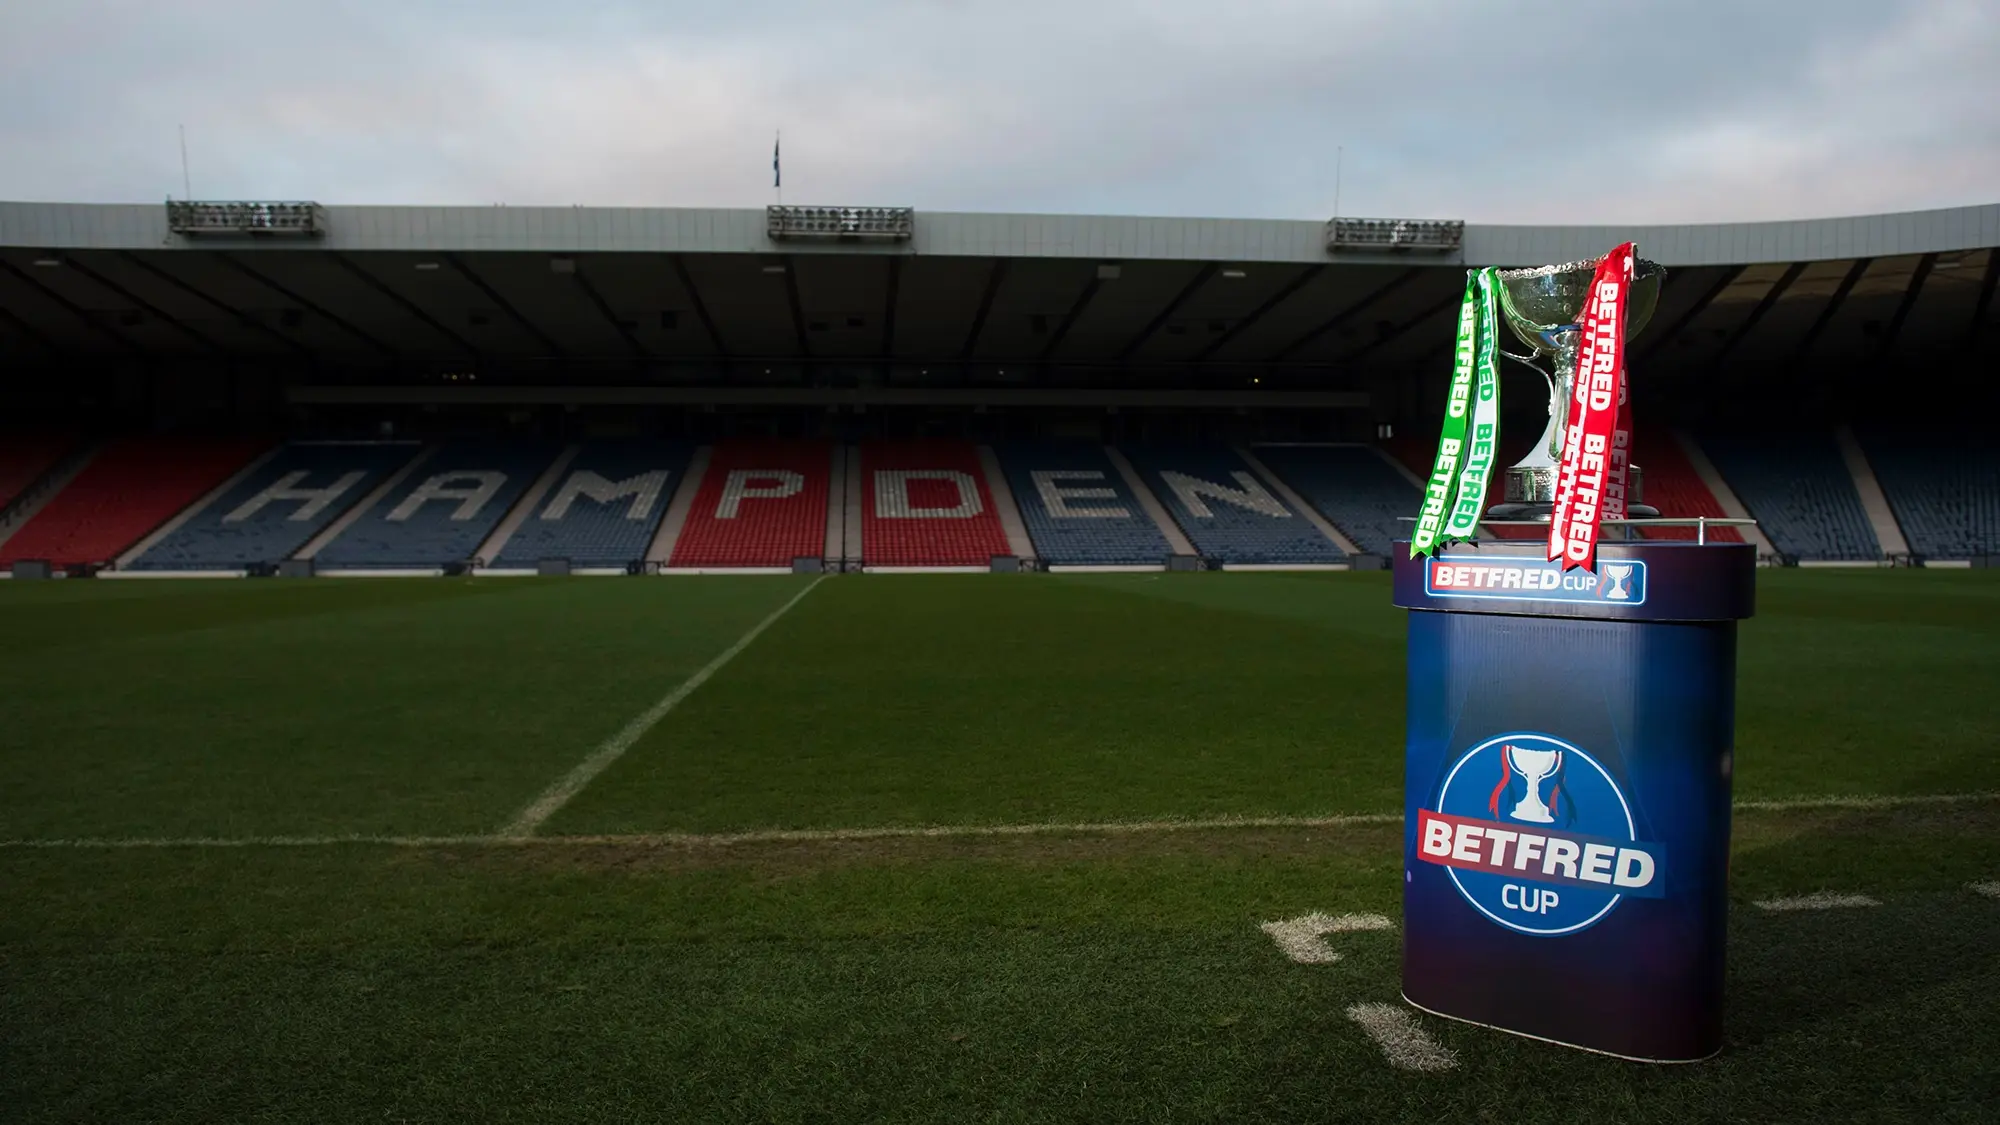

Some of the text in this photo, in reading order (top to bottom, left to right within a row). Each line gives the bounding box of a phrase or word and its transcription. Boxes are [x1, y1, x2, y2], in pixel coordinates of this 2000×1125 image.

[1449, 301, 1474, 418] BETFRED
[1590, 282, 1619, 411] BETFRED
[222, 469, 1292, 523] HAMPDEN
[1415, 437, 1461, 548] BETFRED
[1453, 423, 1493, 529] BETFRED
[1566, 433, 1606, 561] BETFRED
[1435, 566, 1598, 591] BETFRED CUP
[1422, 818, 1656, 888] BETFRED
[1501, 883, 1560, 915] CUP
